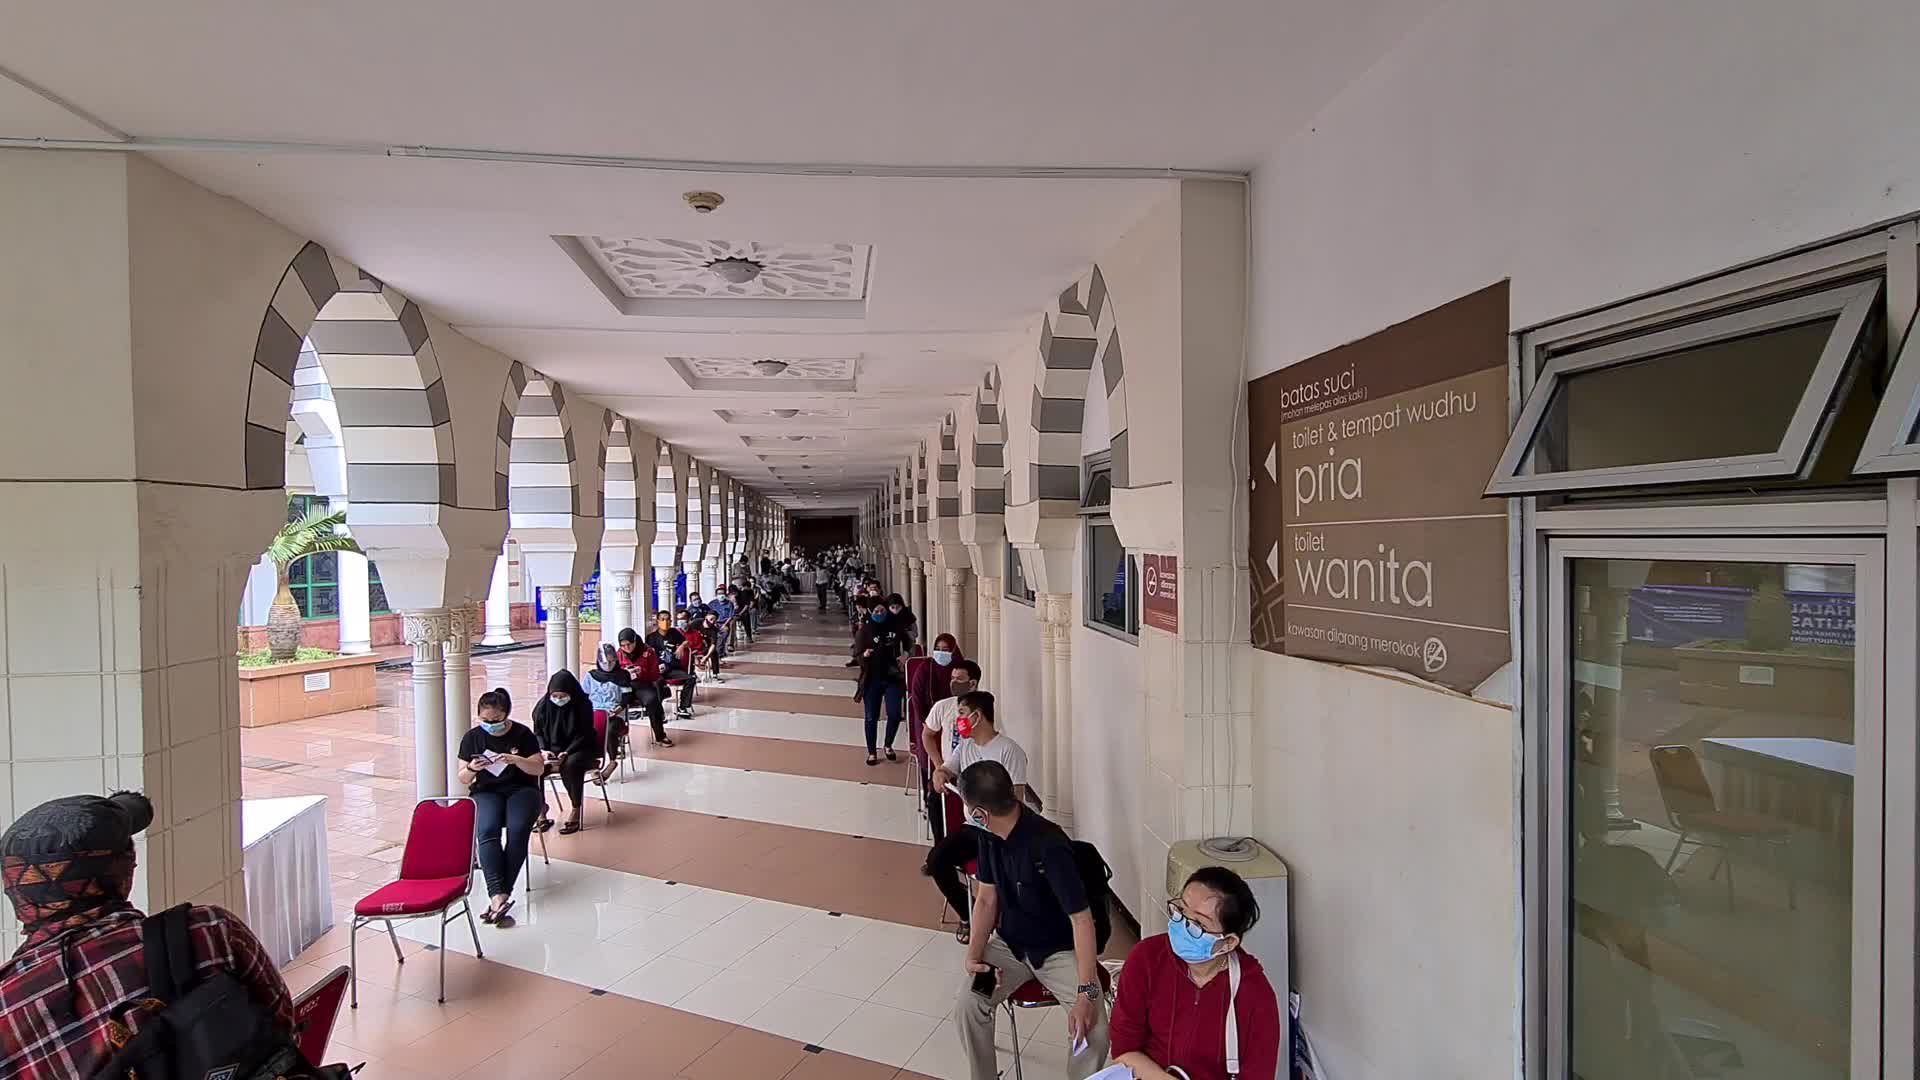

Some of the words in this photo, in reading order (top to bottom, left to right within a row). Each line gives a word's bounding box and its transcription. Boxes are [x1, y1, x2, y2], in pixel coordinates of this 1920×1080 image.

[1280, 381, 1320, 409] batas
[1323, 362, 1355, 396] suci
[1292, 423, 1324, 449] toilet
[1327, 421, 1338, 442] &
[1341, 403, 1401, 438] tempat
[1406, 391, 1477, 423] wudhu
[1295, 447, 1362, 517] pria
[1294, 531, 1325, 552] toilet
[1295, 543, 1433, 608] wanita
[1287, 621, 1326, 641] kawasan
[1327, 629, 1369, 651] dilarang
[1370, 636, 1422, 659] merokok
